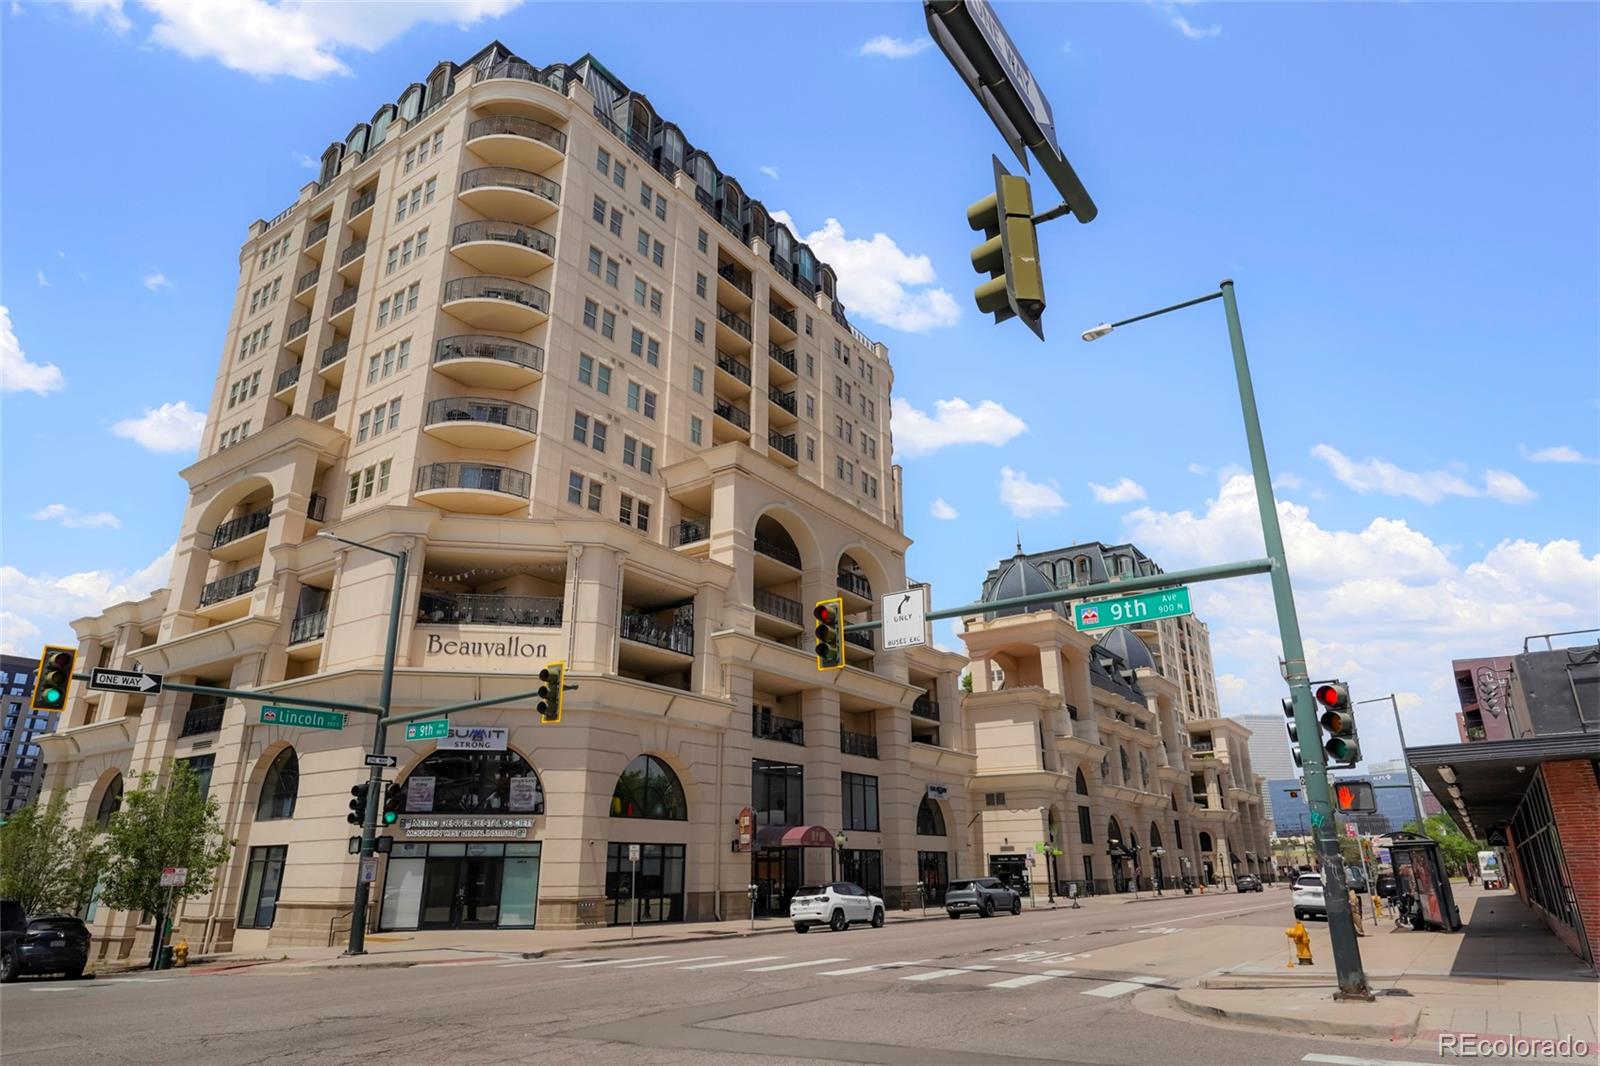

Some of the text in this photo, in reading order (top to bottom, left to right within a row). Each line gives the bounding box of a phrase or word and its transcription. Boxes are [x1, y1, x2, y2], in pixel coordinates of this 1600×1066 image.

[1004, 41, 1030, 97] WAY
[1161, 594, 1177, 602] Ave
[1110, 599, 1147, 620] 9th
[1158, 603, 1175, 613] 900
[893, 613, 912, 622] ONLY
[427, 634, 547, 658] Beauvallon
[99, 674, 142, 686] ONE WAY
[279, 710, 324, 726] Lincoln
[419, 724, 433, 736] 9th
[454, 741, 491, 749] STRONG
